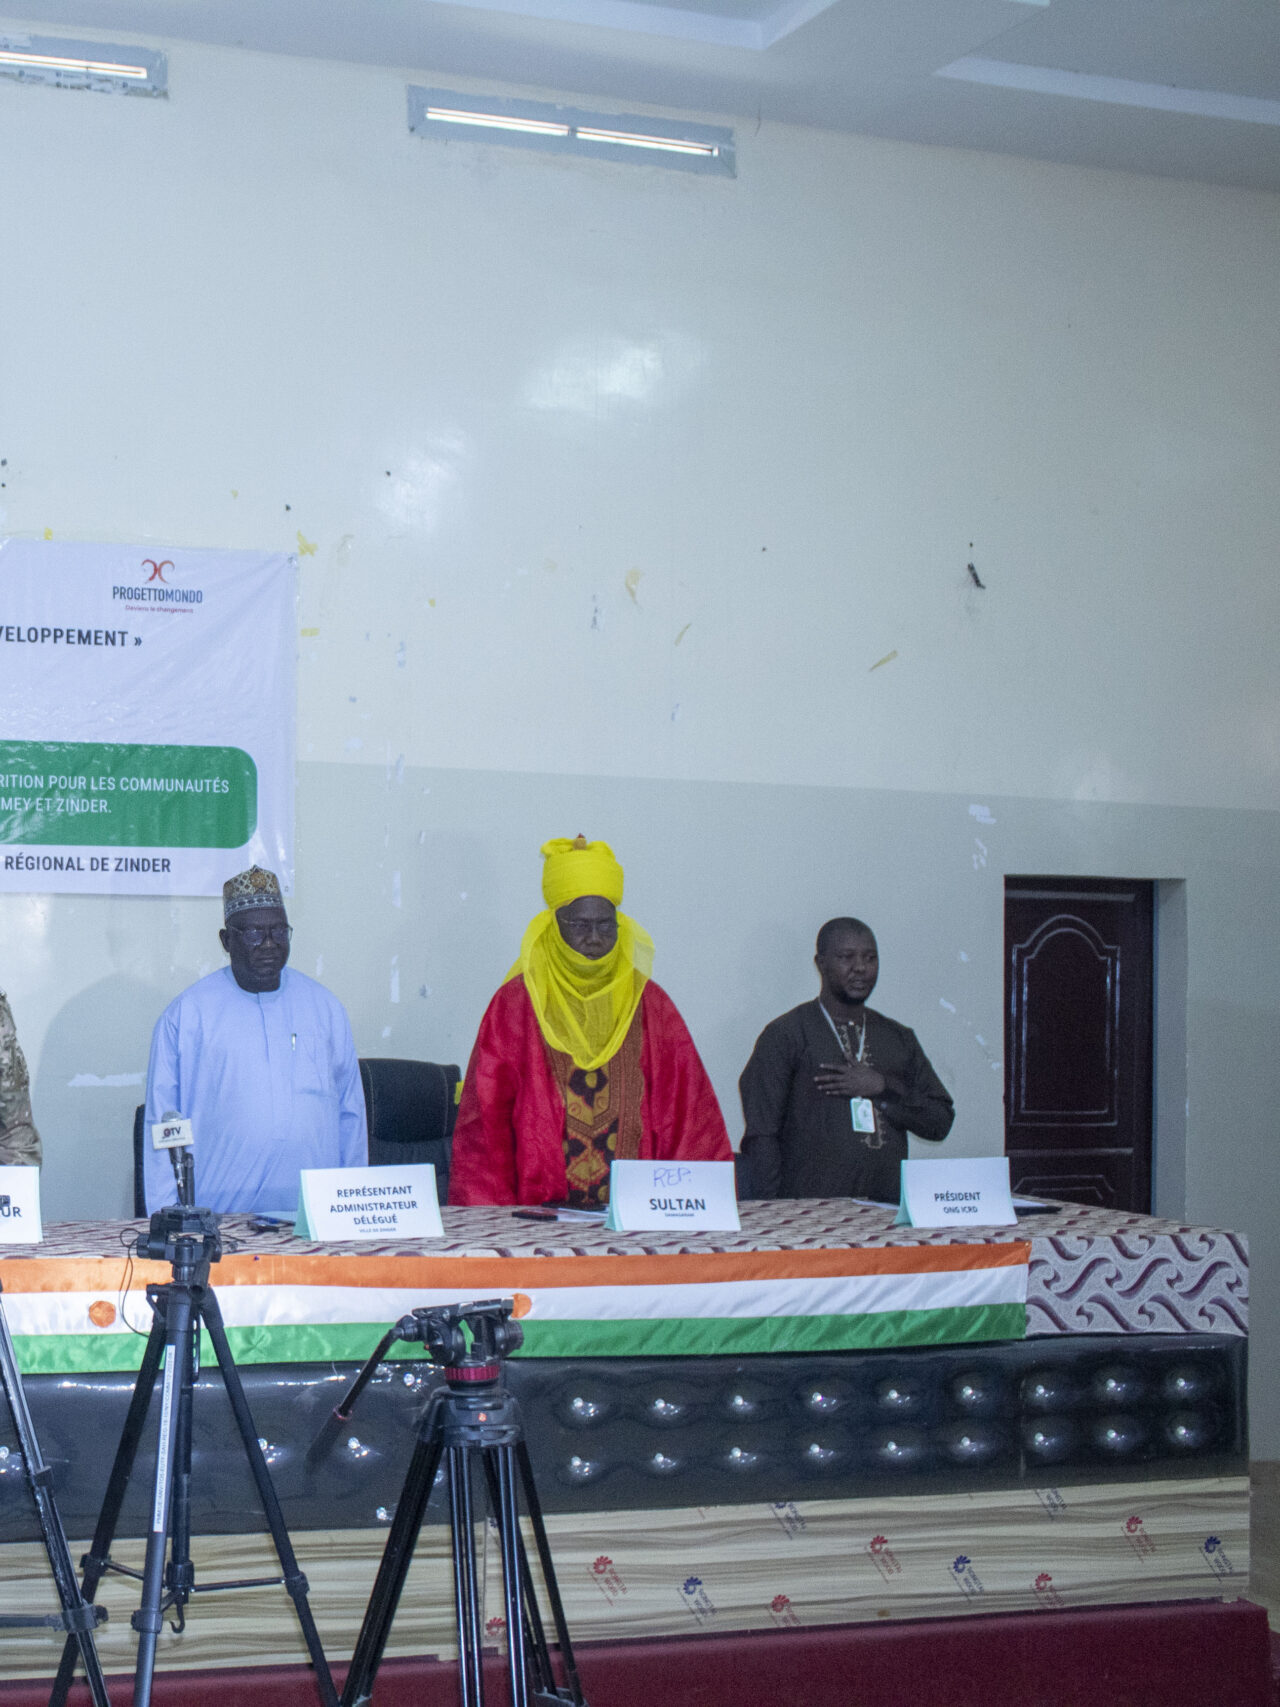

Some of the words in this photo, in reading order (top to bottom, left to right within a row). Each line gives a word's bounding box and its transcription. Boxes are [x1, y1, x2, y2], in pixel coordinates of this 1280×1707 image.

[112, 585, 203, 604] PROGETTOMONDO
[49, 775, 87, 790] POUR
[91, 776, 116, 791] LES
[120, 775, 230, 793] COMMUNAUTÉS
[35, 798, 51, 812] ET
[55, 798, 112, 814] ZINDER.
[5, 852, 85, 871] RÉGIONAL
[90, 857, 110, 871] DE
[115, 857, 171, 873] ZINDER
[337, 1185, 413, 1198] REPRÉSENTANT
[934, 1190, 981, 1202] PRÉSIDENT
[329, 1200, 418, 1213] ADMINISTRATEUR
[649, 1198, 706, 1211] SULTAN
[353, 1213, 398, 1225] DÉLÉGUÉ
